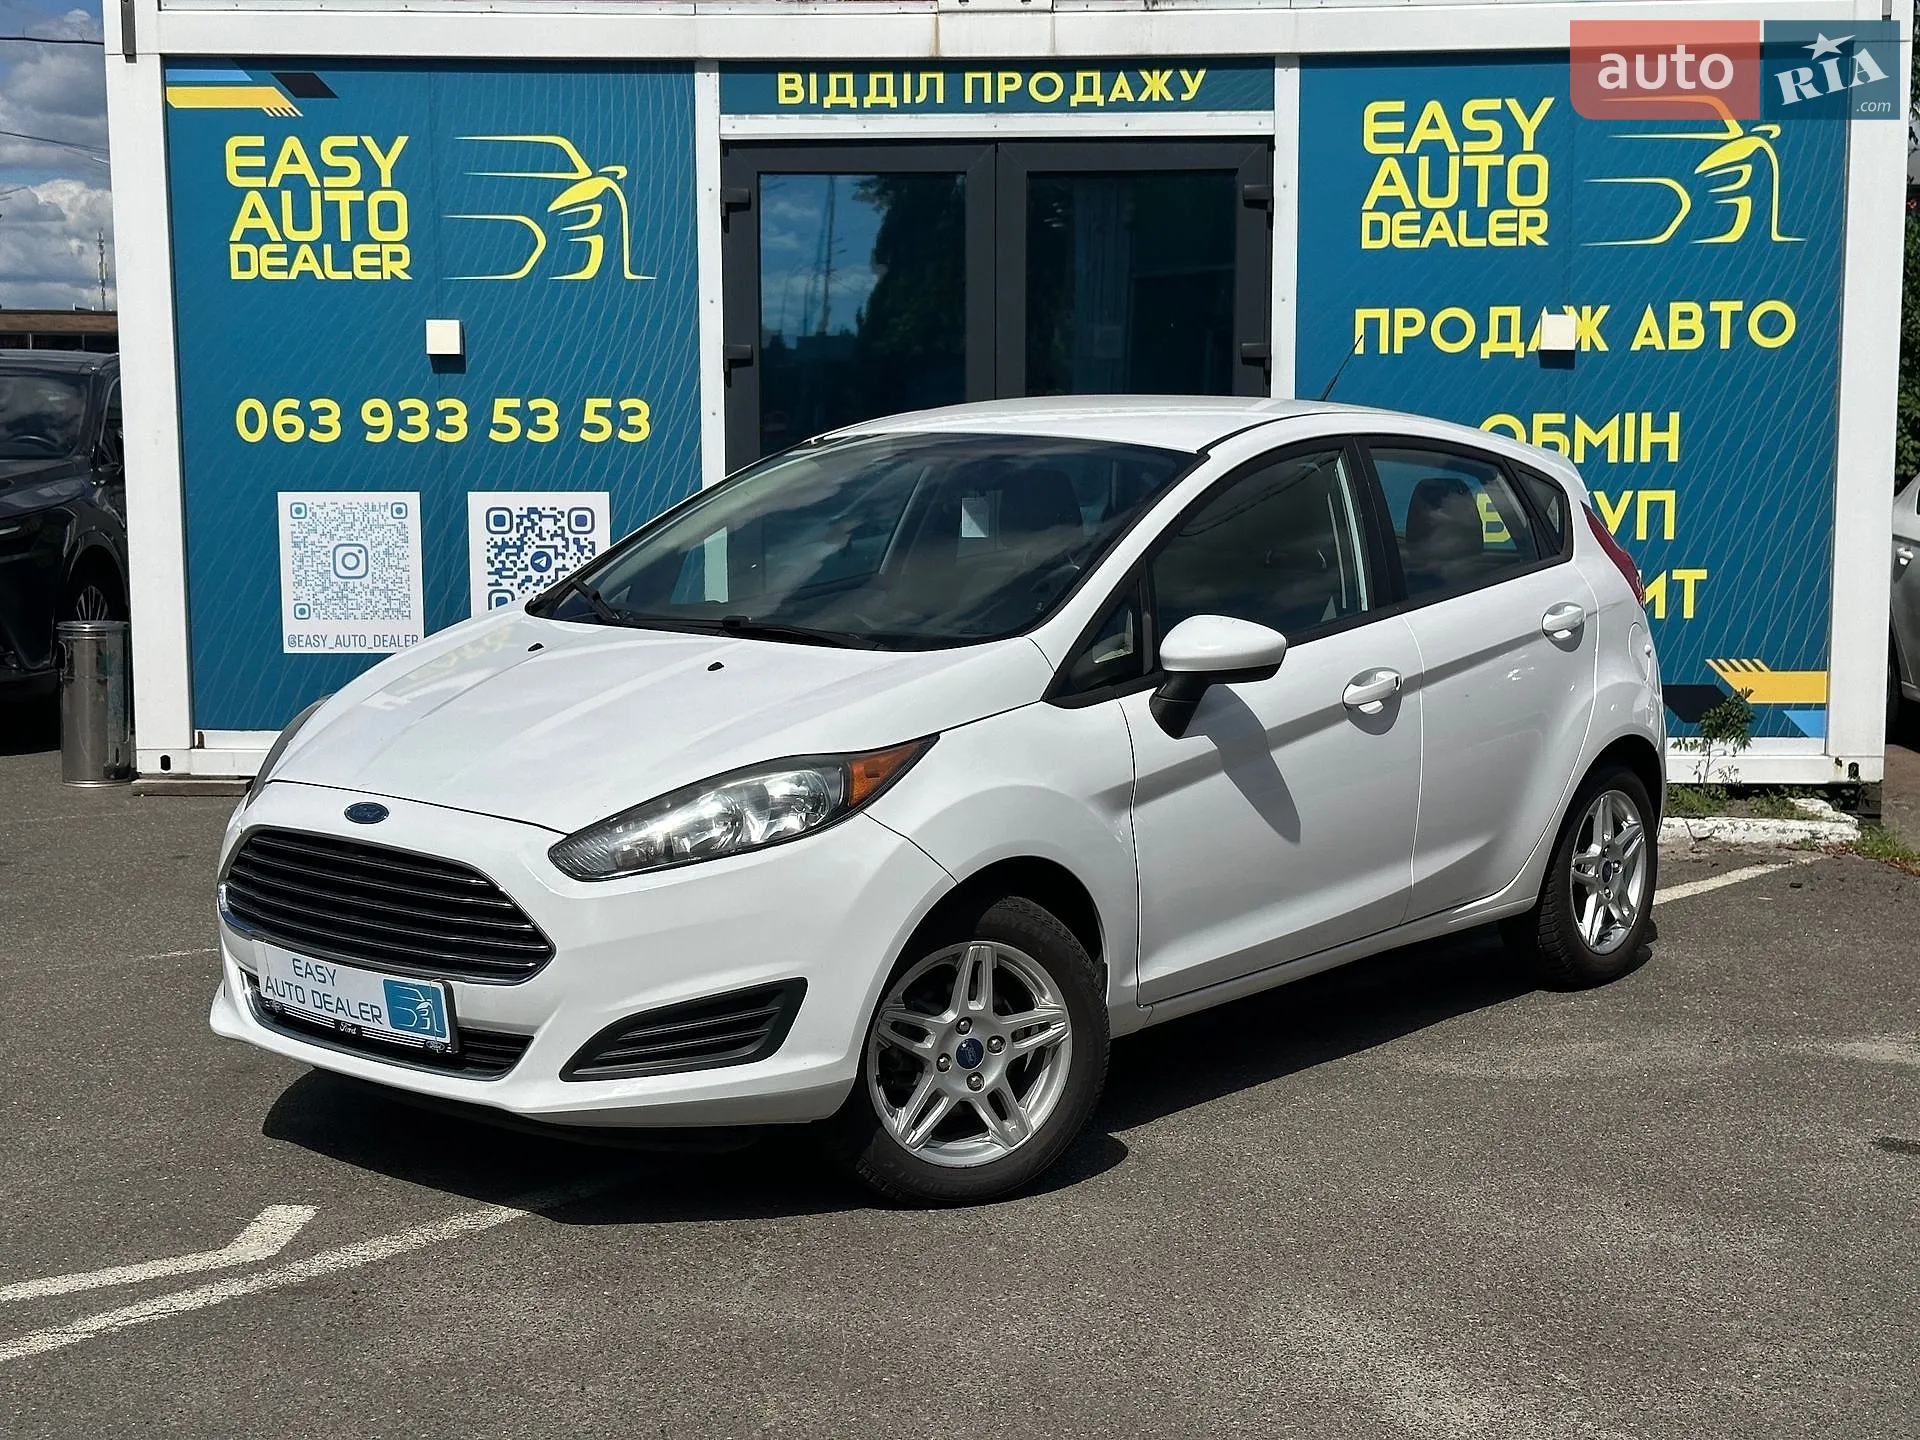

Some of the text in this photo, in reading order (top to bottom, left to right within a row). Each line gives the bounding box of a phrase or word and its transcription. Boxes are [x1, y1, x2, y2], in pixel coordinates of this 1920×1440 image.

[777, 68, 1208, 109] ВІДДІЛ ПРОДАЖУ
[1363, 97, 1555, 154] EASY
[225, 136, 409, 188] EASY
[1362, 154, 1550, 210] AUTO
[229, 190, 409, 242] AUTO
[1361, 208, 1550, 249] DEALER
[230, 244, 413, 280] DEALER
[1630, 300, 1796, 352] АВТО
[235, 398, 652, 444] 063 933 53 53
[292, 957, 337, 987] EASY
[265, 975, 384, 1025] AUTO DEALER
